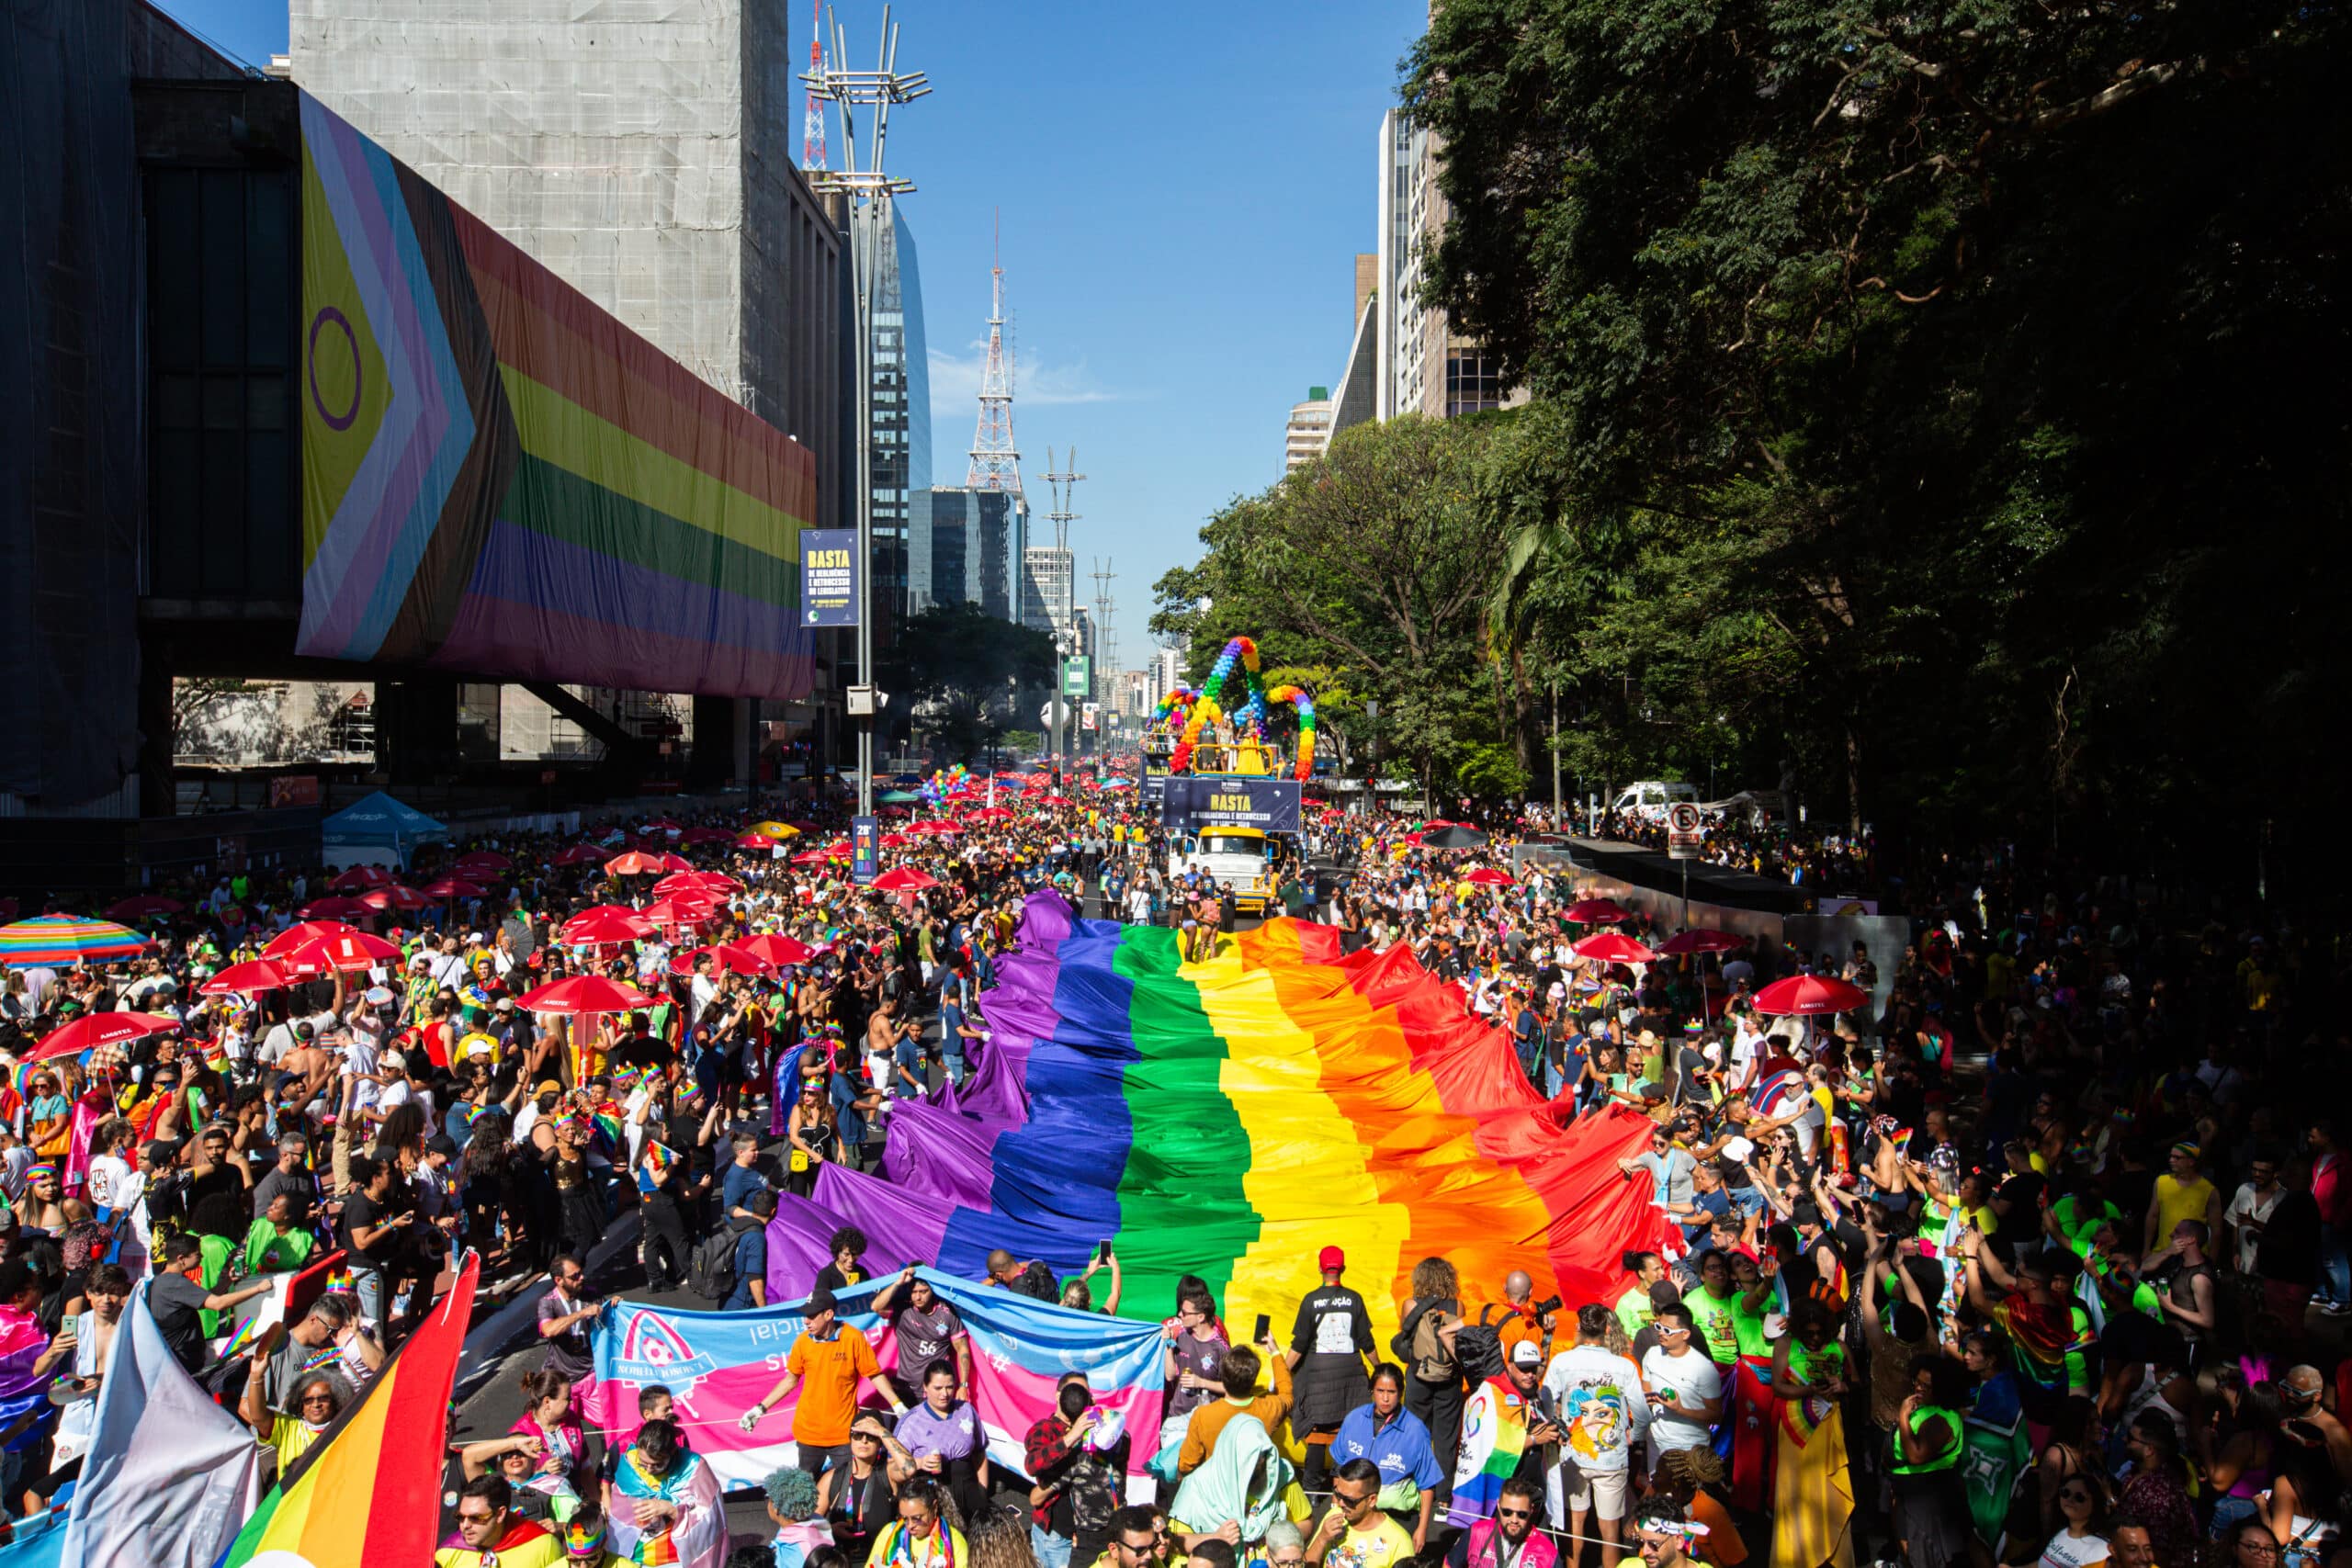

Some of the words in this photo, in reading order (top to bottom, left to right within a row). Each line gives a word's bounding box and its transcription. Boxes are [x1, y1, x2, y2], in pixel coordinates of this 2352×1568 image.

[808, 549, 850, 568] BASTA
[1210, 794, 1252, 811] BASTA
[543, 998, 570, 1008] AMSTEL
[100, 1027, 132, 1040] AMSTEL
[1313, 1296, 1352, 1309] PROUÇÃO
[919, 1340, 936, 1356] 56
